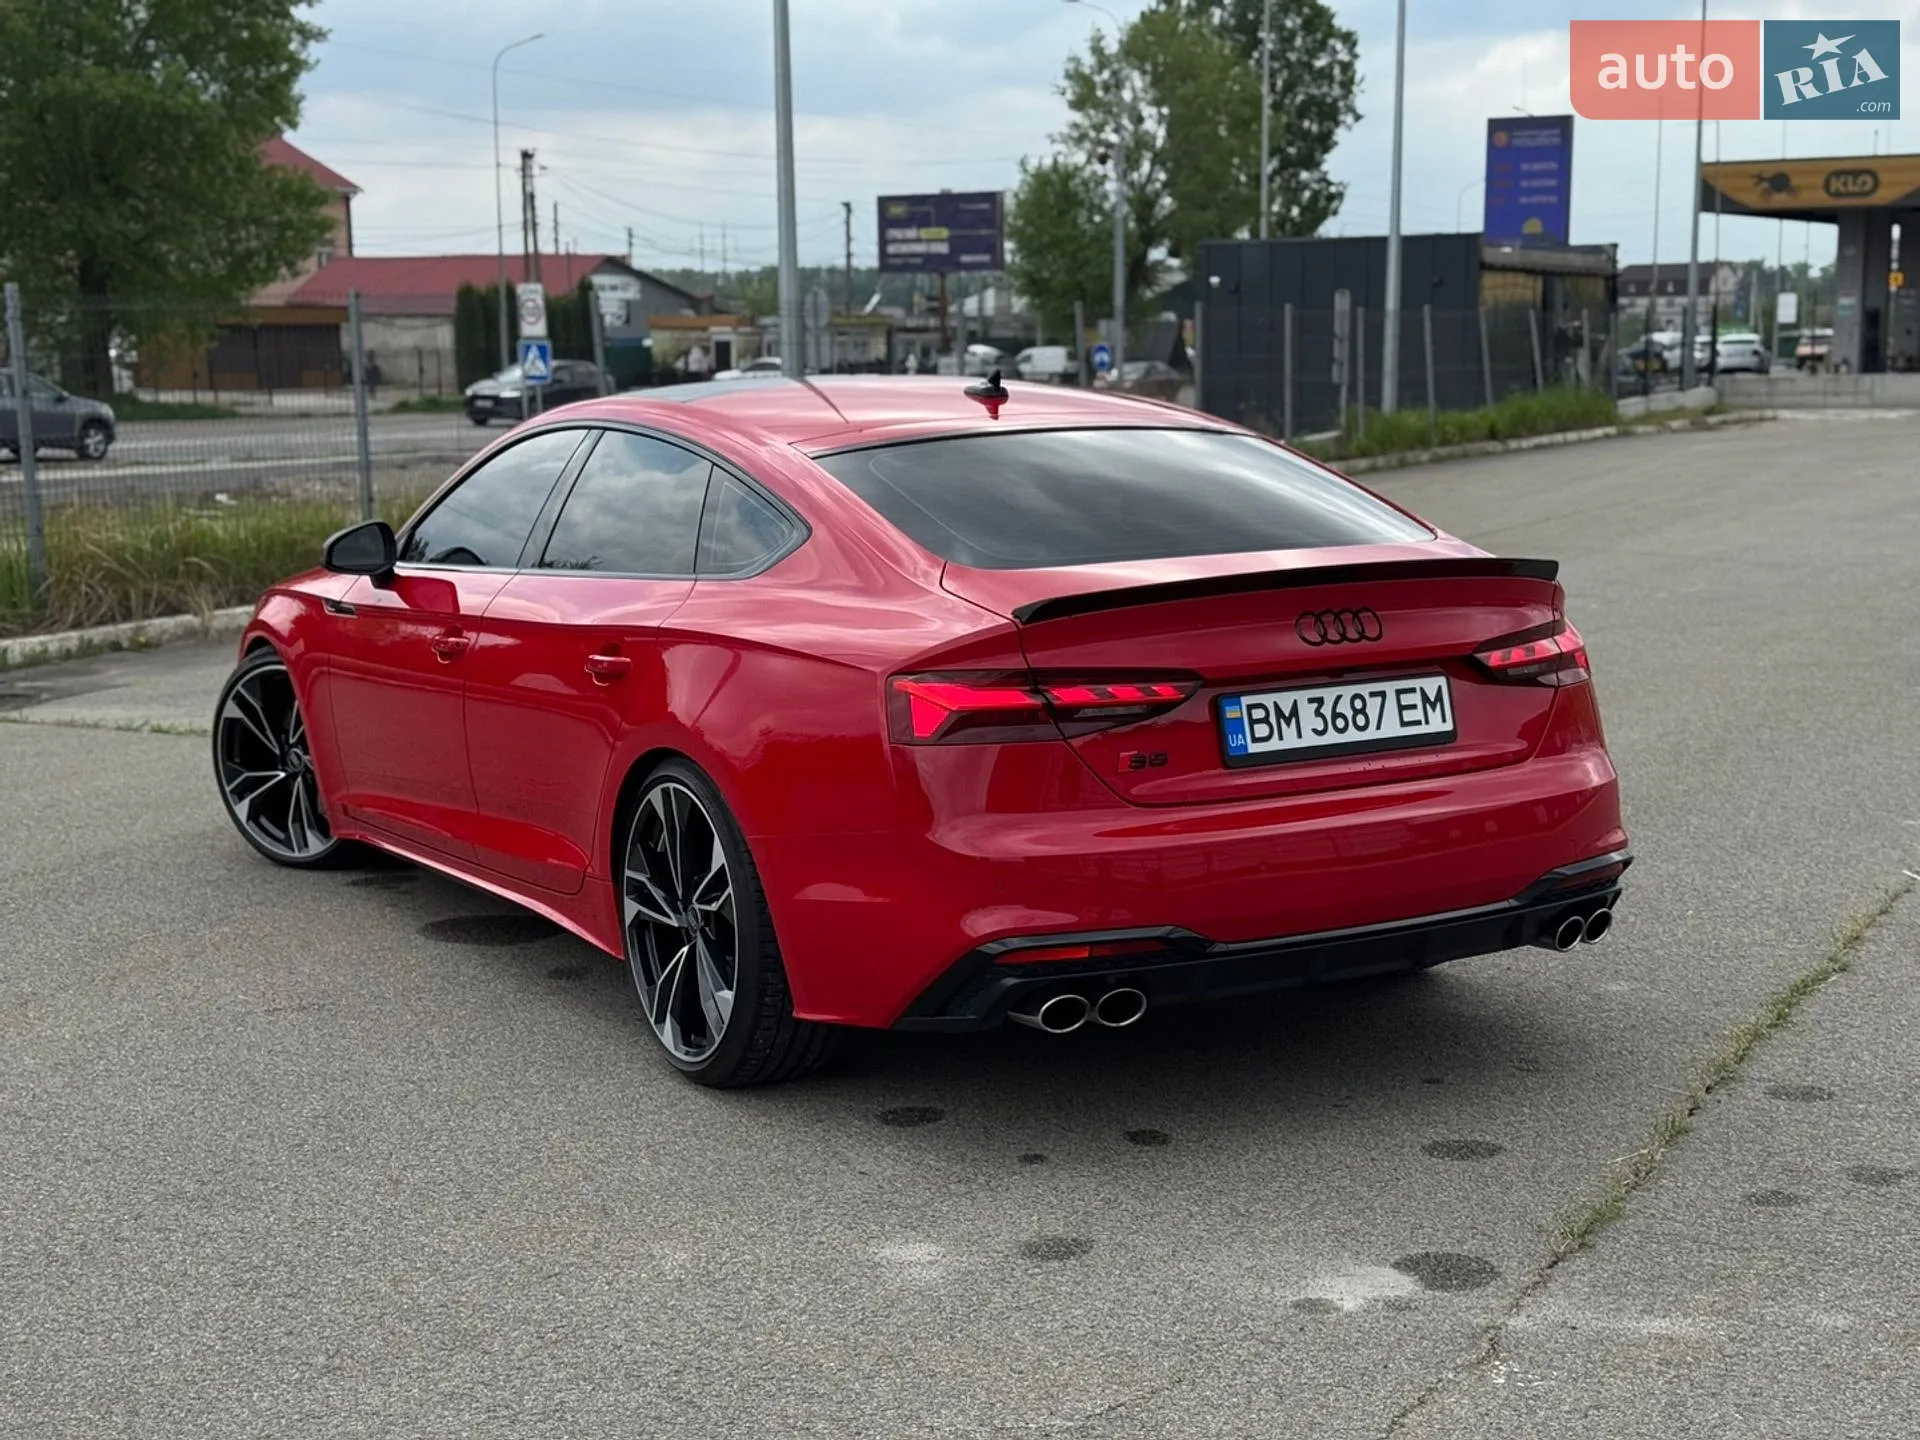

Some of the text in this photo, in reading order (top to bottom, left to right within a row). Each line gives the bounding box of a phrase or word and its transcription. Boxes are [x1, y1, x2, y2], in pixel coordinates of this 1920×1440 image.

[1829, 173, 1875, 194] KLO
[1246, 685, 1447, 744] BM 3687 EM
[1229, 734, 1245, 747] UA
